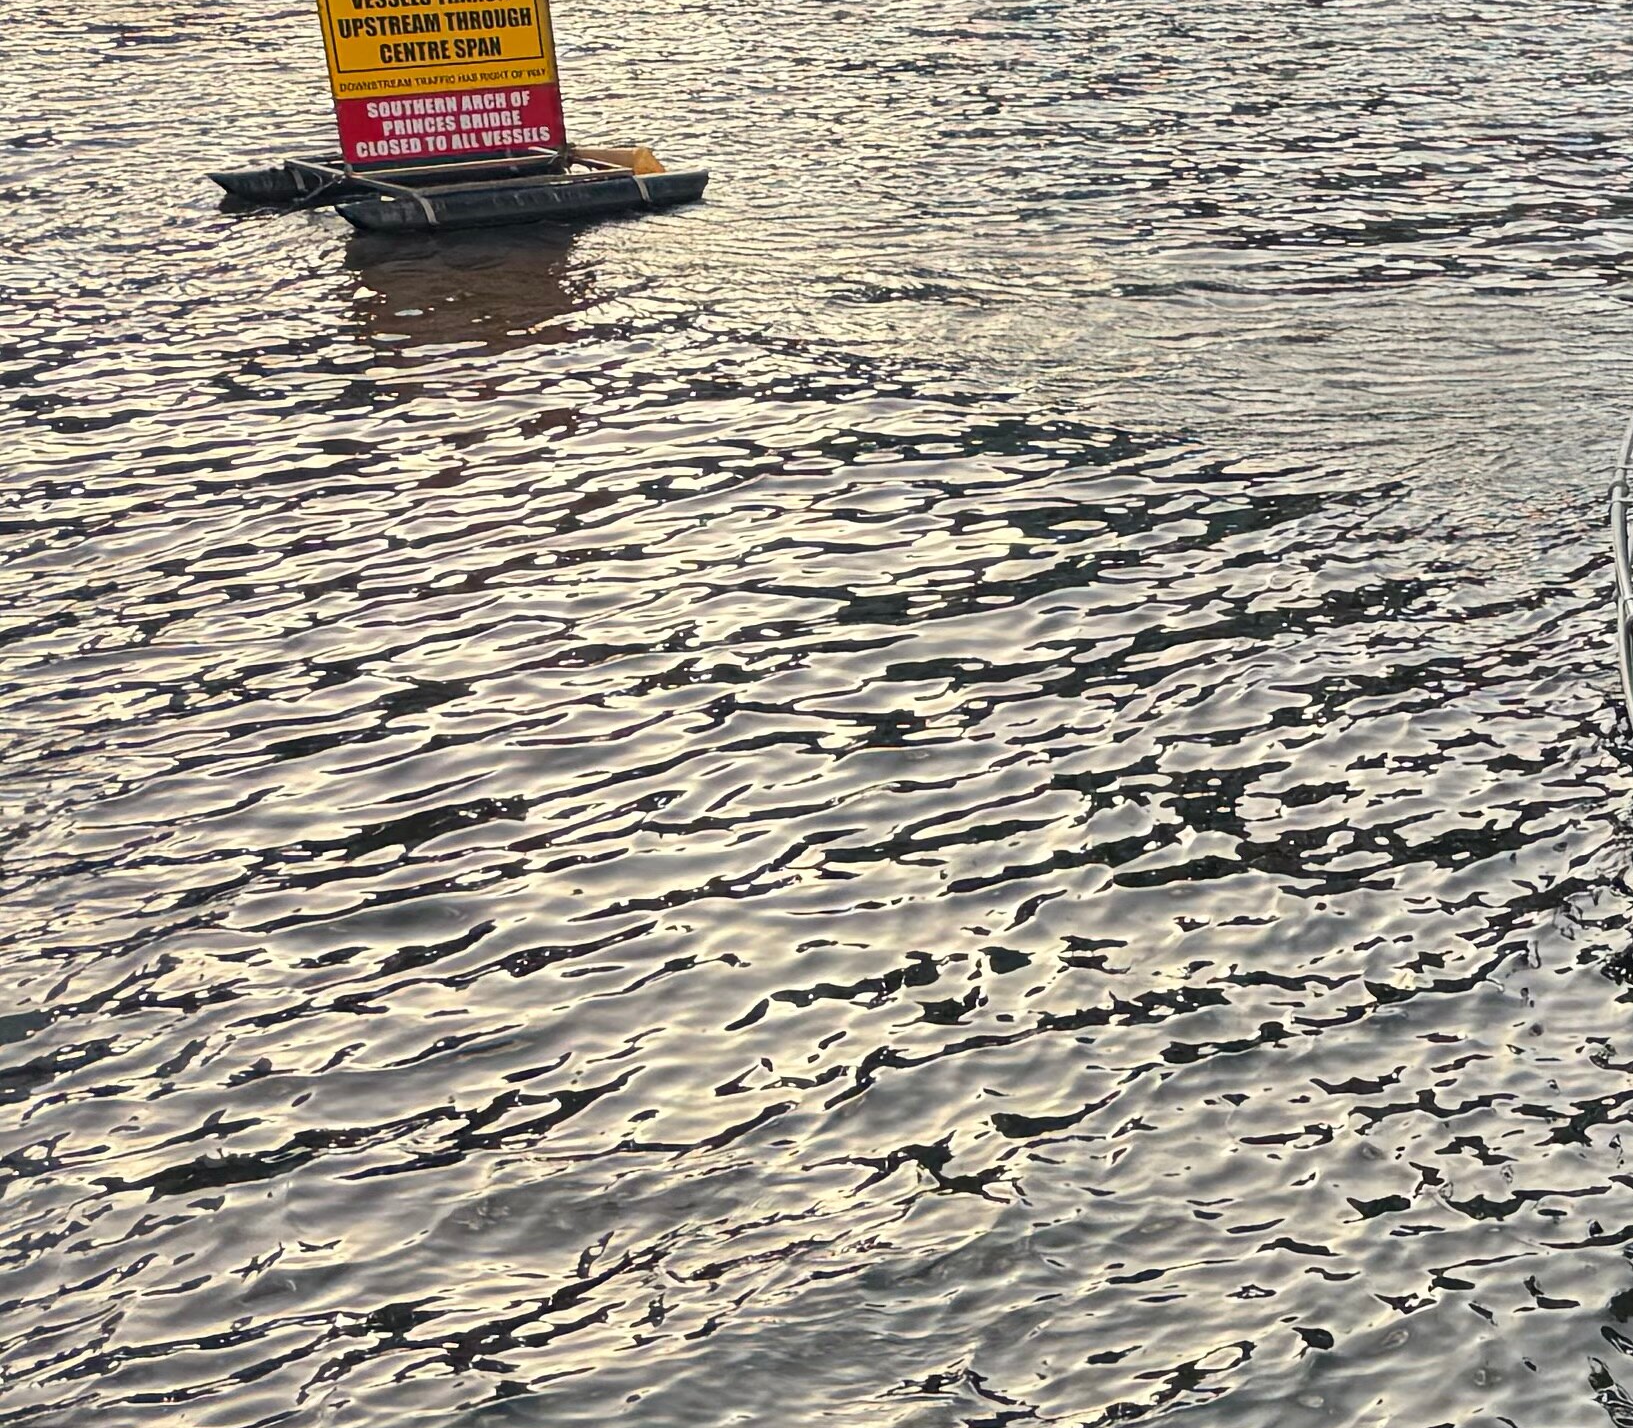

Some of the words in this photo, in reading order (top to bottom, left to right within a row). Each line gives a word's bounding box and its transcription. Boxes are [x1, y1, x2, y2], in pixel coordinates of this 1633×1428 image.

[337, 13, 441, 39] UPSTREAM
[443, 7, 532, 31] THROUGH
[380, 39, 451, 64] CENTRE
[453, 36, 502, 58] SPAN
[340, 77, 412, 92] DOWNSTREAM
[415, 74, 455, 85] TRAFFIC
[511, 70, 523, 79] OF
[366, 96, 457, 118] SOUTHERN
[461, 92, 507, 111] ARCH
[510, 90, 531, 107] OF
[382, 115, 456, 136] PRINCES
[460, 110, 522, 130] BRIDGE
[356, 137, 422, 158] CLOSED
[424, 135, 447, 152] TO
[452, 132, 479, 150] ALL
[481, 126, 550, 147] VESSELS
